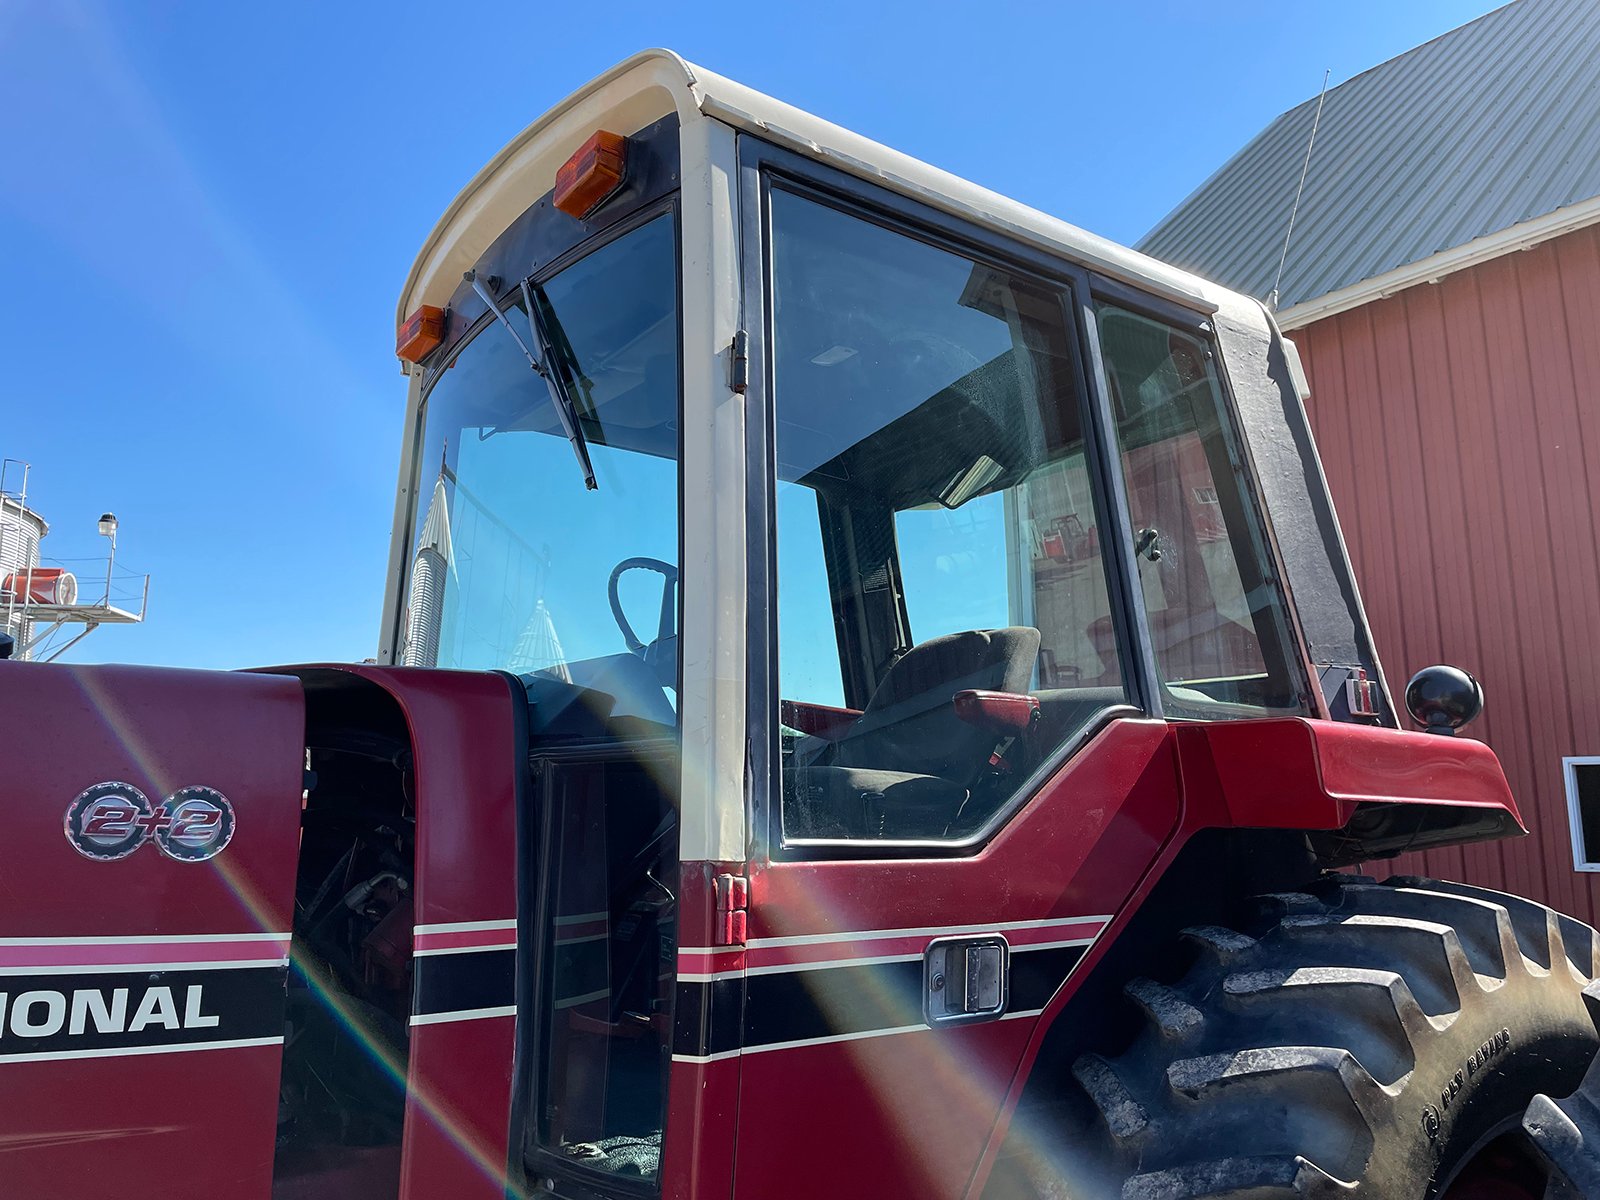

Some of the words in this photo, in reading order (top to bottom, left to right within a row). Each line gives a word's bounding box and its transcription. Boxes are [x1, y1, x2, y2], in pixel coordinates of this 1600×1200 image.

[80, 805, 222, 838] 2+2
[1441, 1068, 1464, 1110] PLY
[1467, 1027, 1510, 1077] RATING
